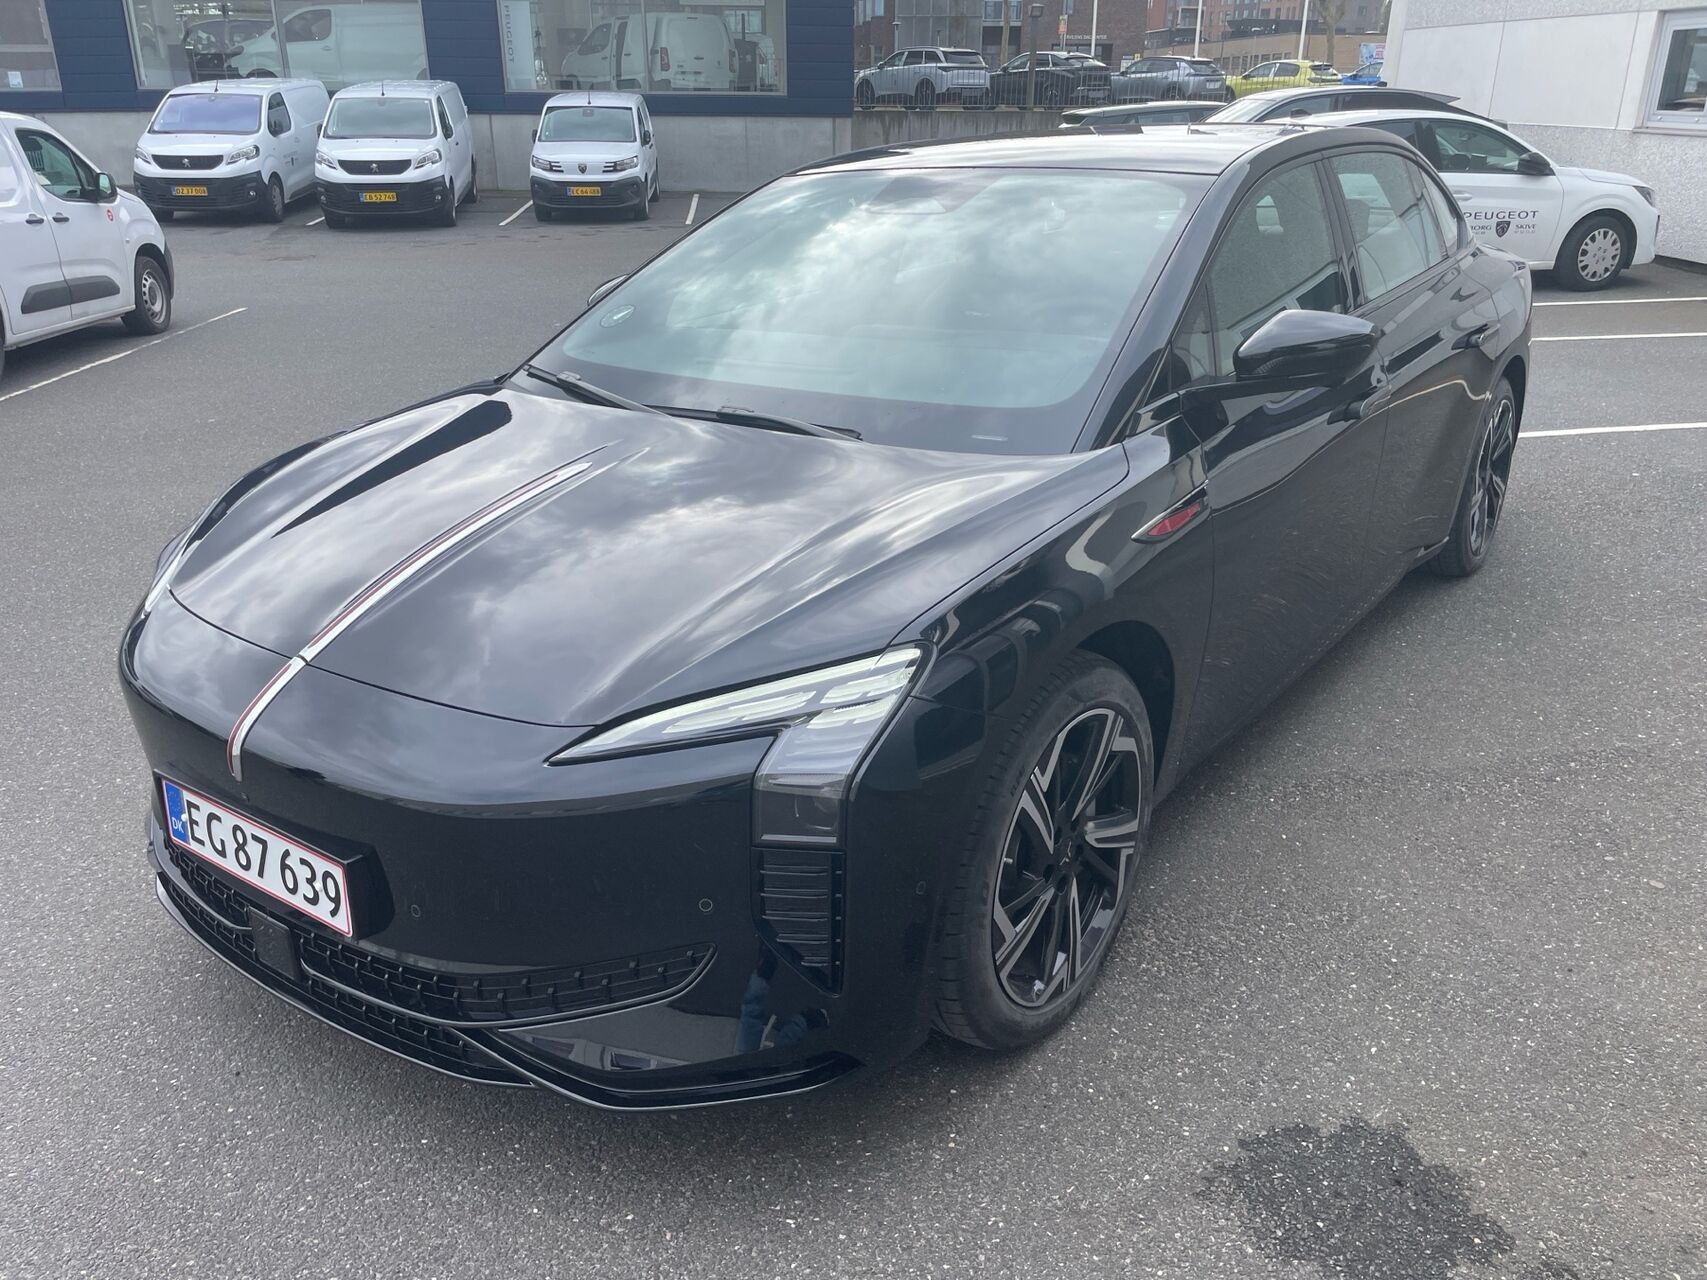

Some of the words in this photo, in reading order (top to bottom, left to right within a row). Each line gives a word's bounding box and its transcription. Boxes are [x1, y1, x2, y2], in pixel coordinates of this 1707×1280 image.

[503, 5, 515, 64] PEUGEOT
[1463, 210, 1539, 220] PEUGEOT
[171, 816, 185, 834] DK
[185, 799, 227, 859] EG
[231, 823, 269, 879] 87
[279, 848, 342, 919] 639
